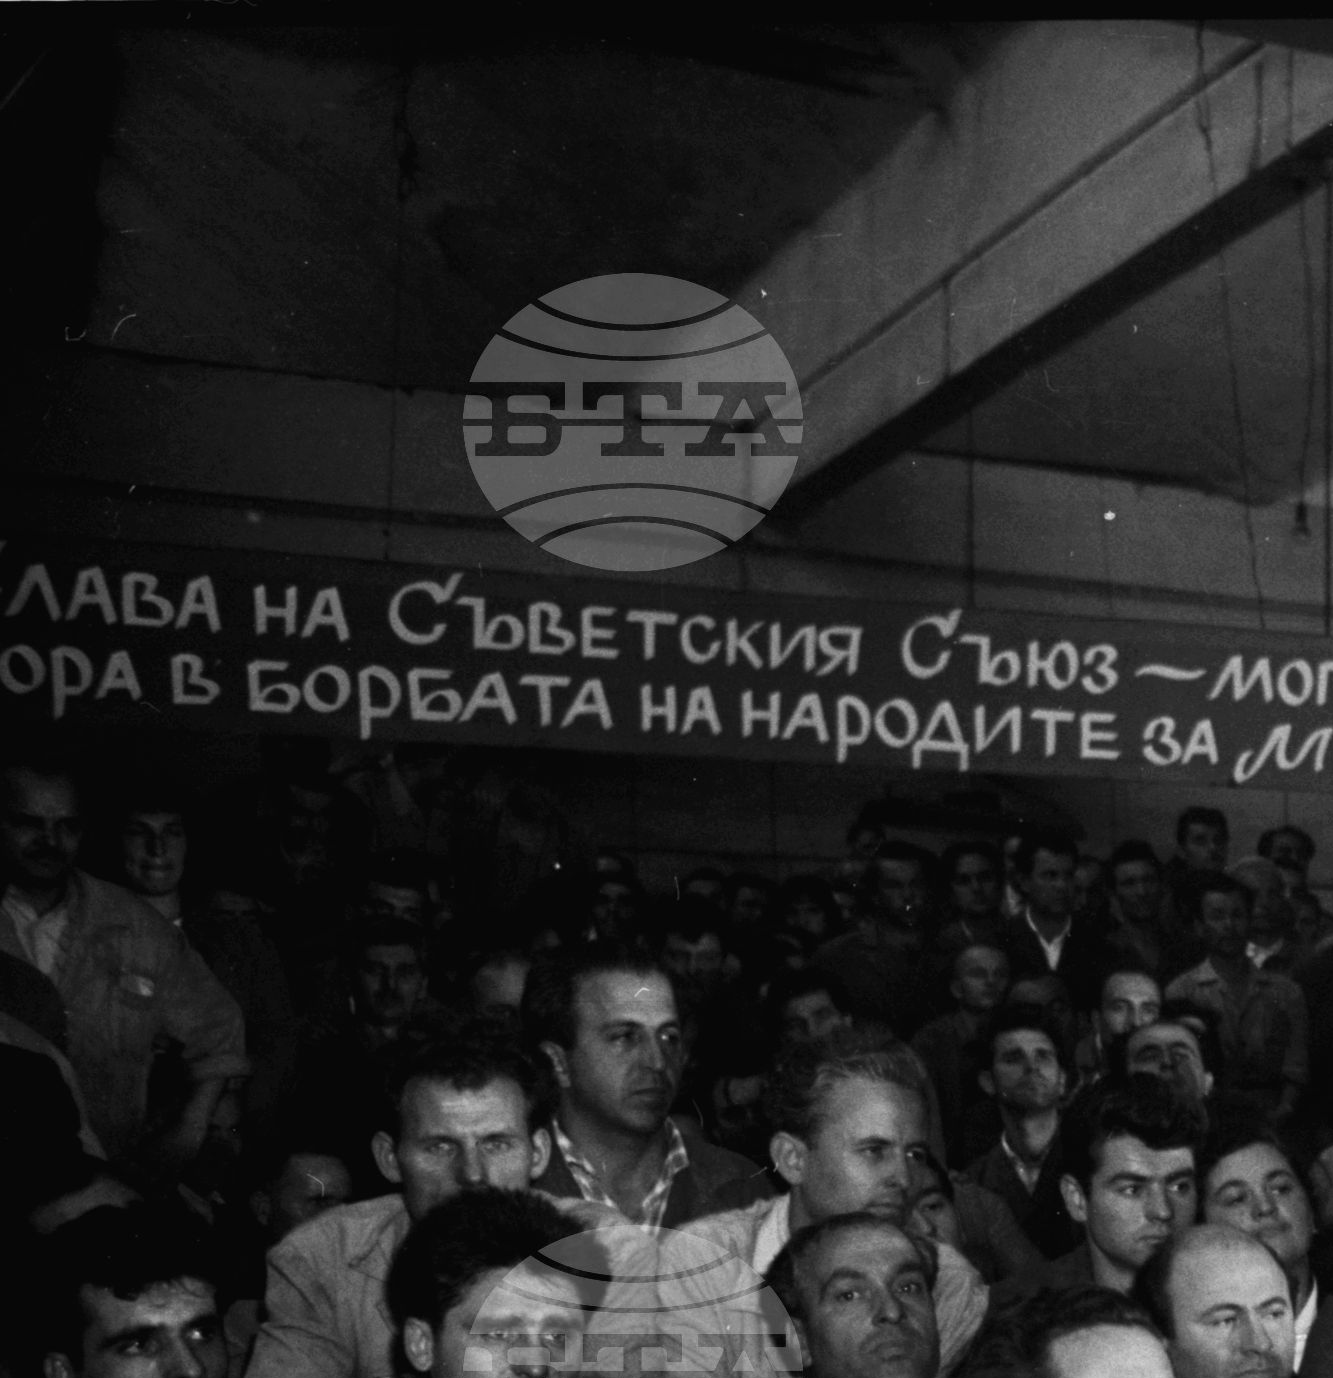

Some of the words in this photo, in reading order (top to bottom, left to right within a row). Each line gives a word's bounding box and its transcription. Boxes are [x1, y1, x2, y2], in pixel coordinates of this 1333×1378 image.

[0, 540, 222, 634] ЛАВА
[253, 584, 350, 642] НА
[388, 573, 863, 676] СЪВЕТСКИЯ
[901, 608, 1120, 695] СЪЮЗ
[246, 659, 614, 740] БОРБАТА
[639, 683, 722, 735] НА
[740, 689, 1121, 772] НАРОДИТЕ
[1141, 715, 1220, 767] ЗА
